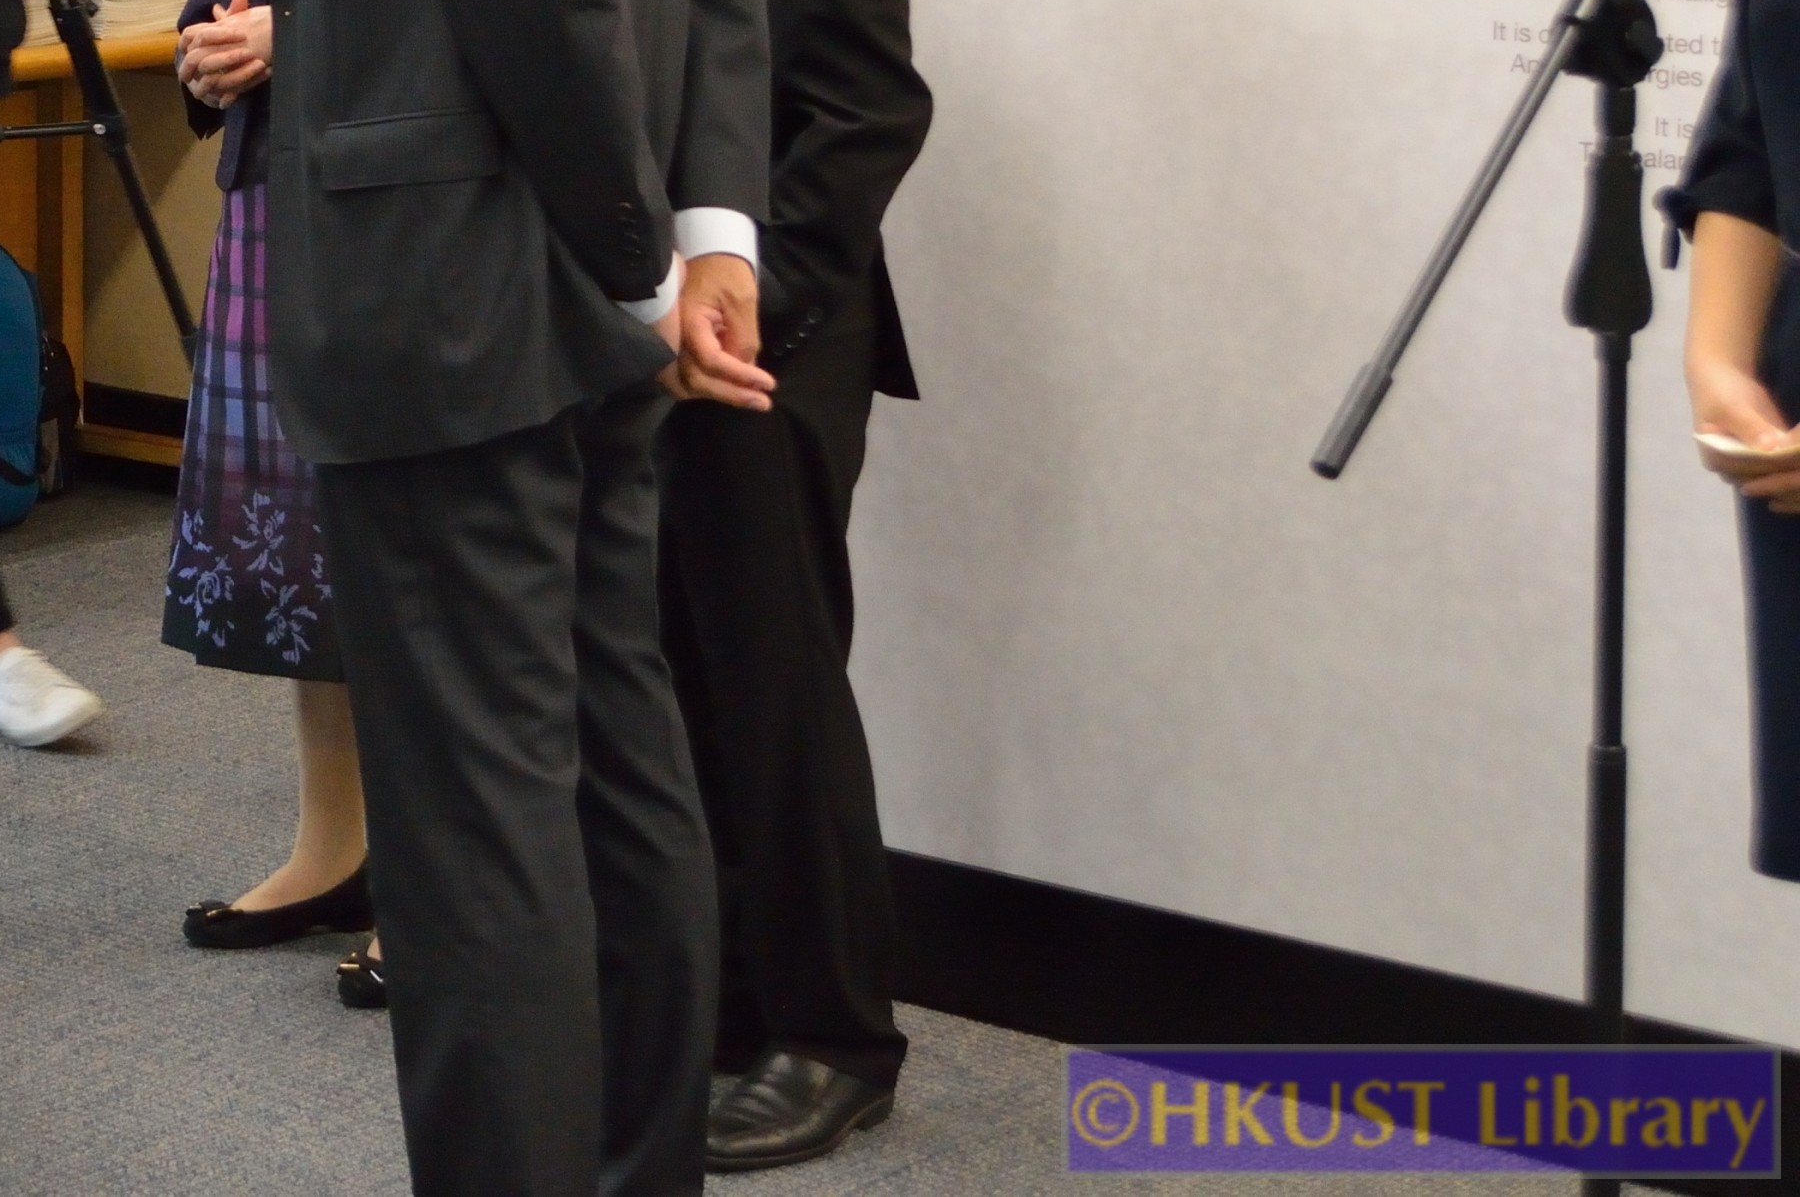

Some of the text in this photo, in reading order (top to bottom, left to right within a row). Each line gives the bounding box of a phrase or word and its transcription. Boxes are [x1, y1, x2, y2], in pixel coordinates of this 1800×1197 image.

[1493, 20, 1506, 42] It
[1514, 21, 1532, 43] is
[1655, 116, 1669, 137] It
